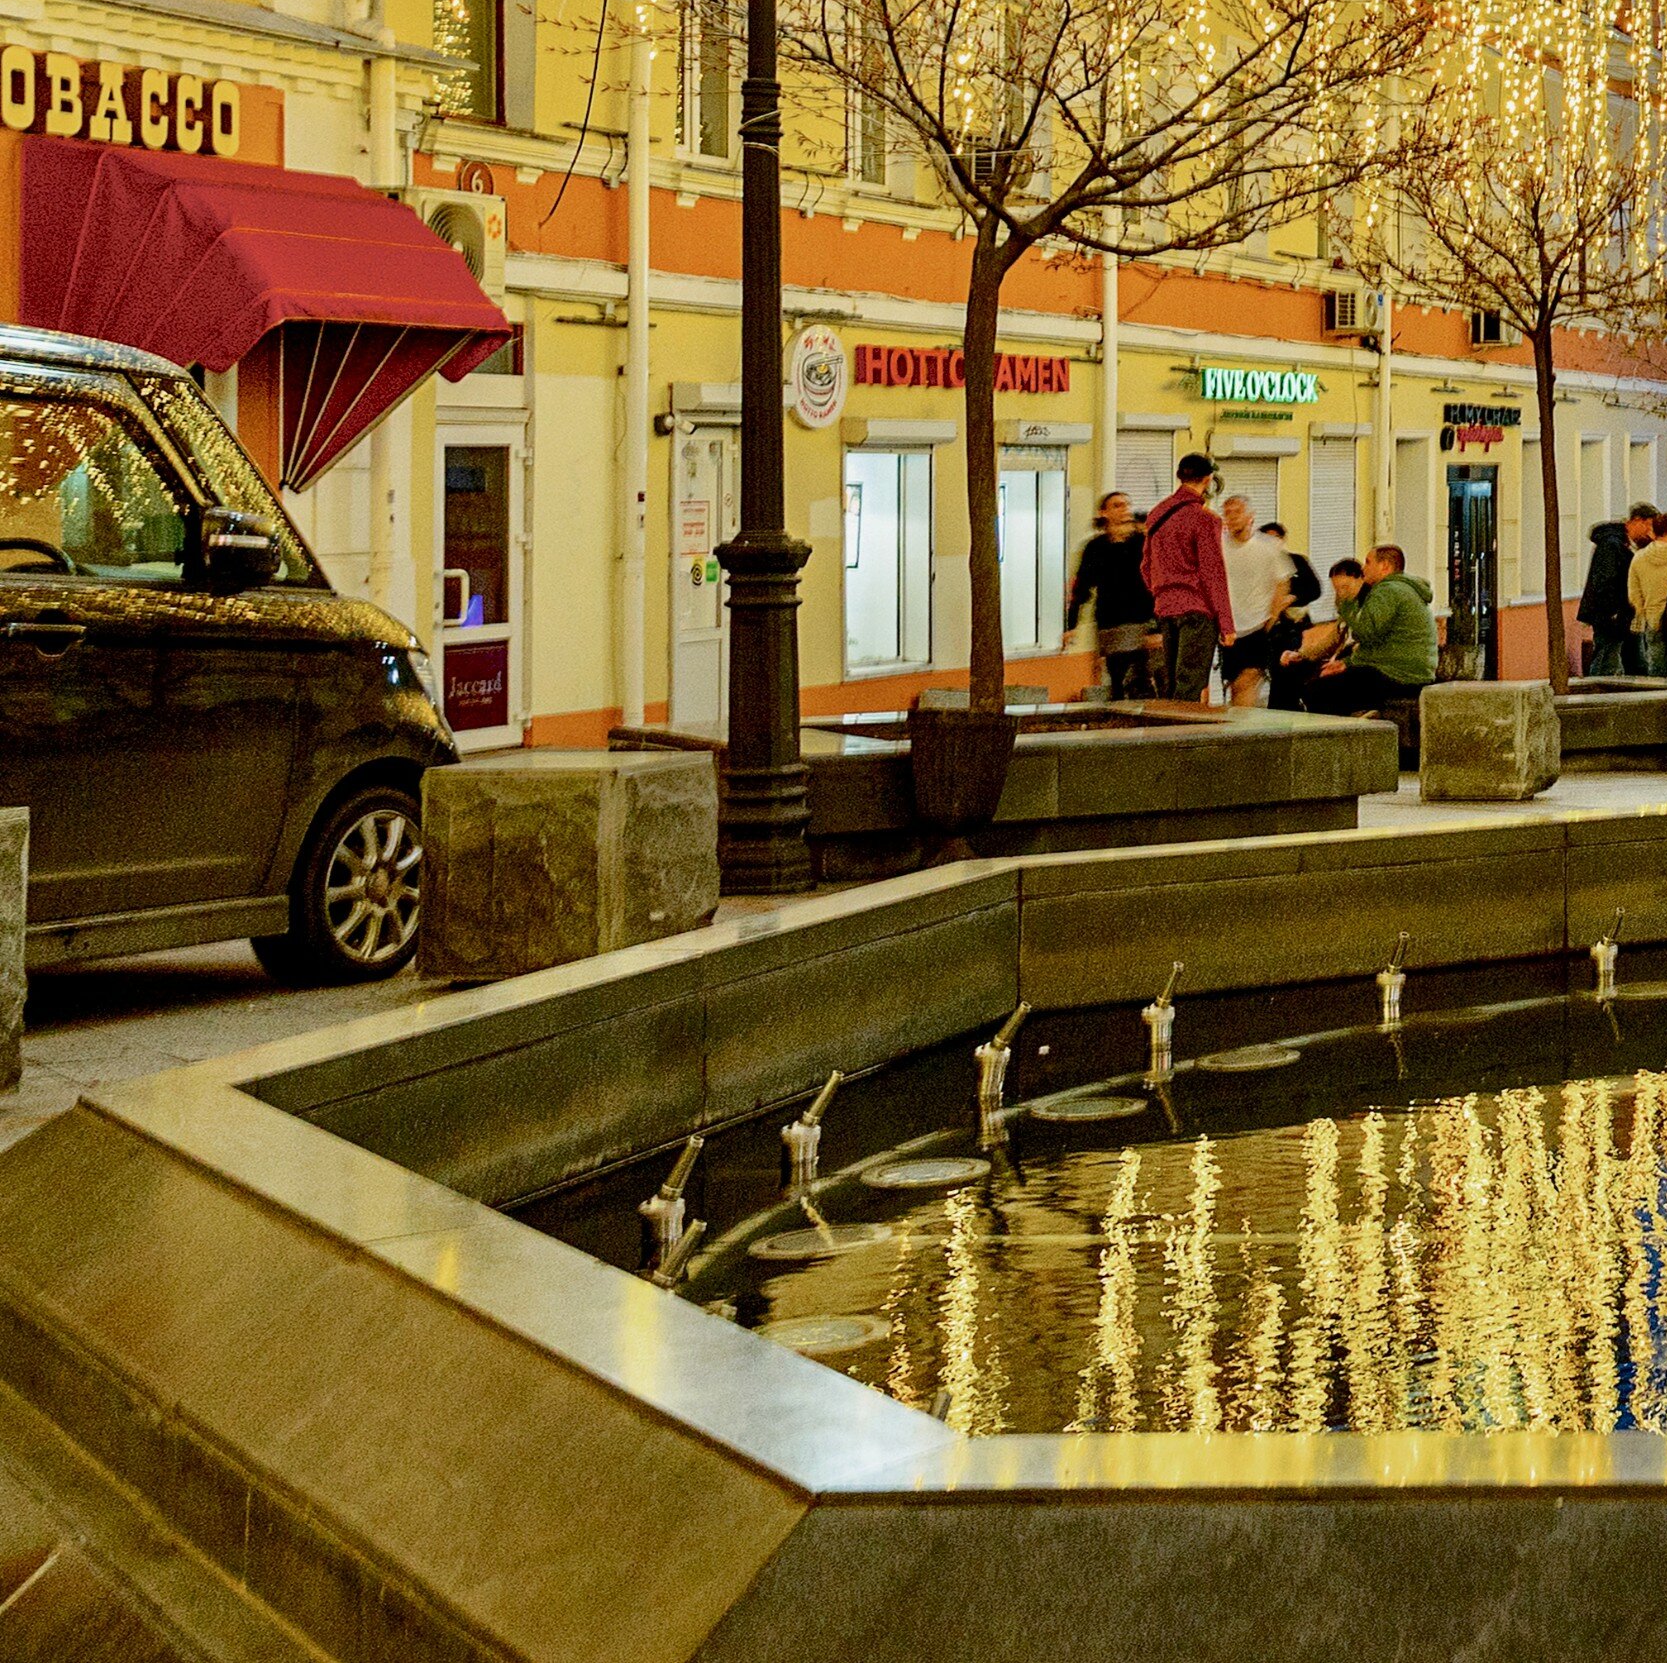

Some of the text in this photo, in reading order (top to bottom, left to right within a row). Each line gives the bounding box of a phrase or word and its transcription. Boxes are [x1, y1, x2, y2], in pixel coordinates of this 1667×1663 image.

[1, 45, 241, 157] OBACCO
[471, 169, 484, 194] 6
[858, 344, 1070, 393] HOTTO AMEN
[1202, 367, 1319, 404] FIVE O'CLOCK
